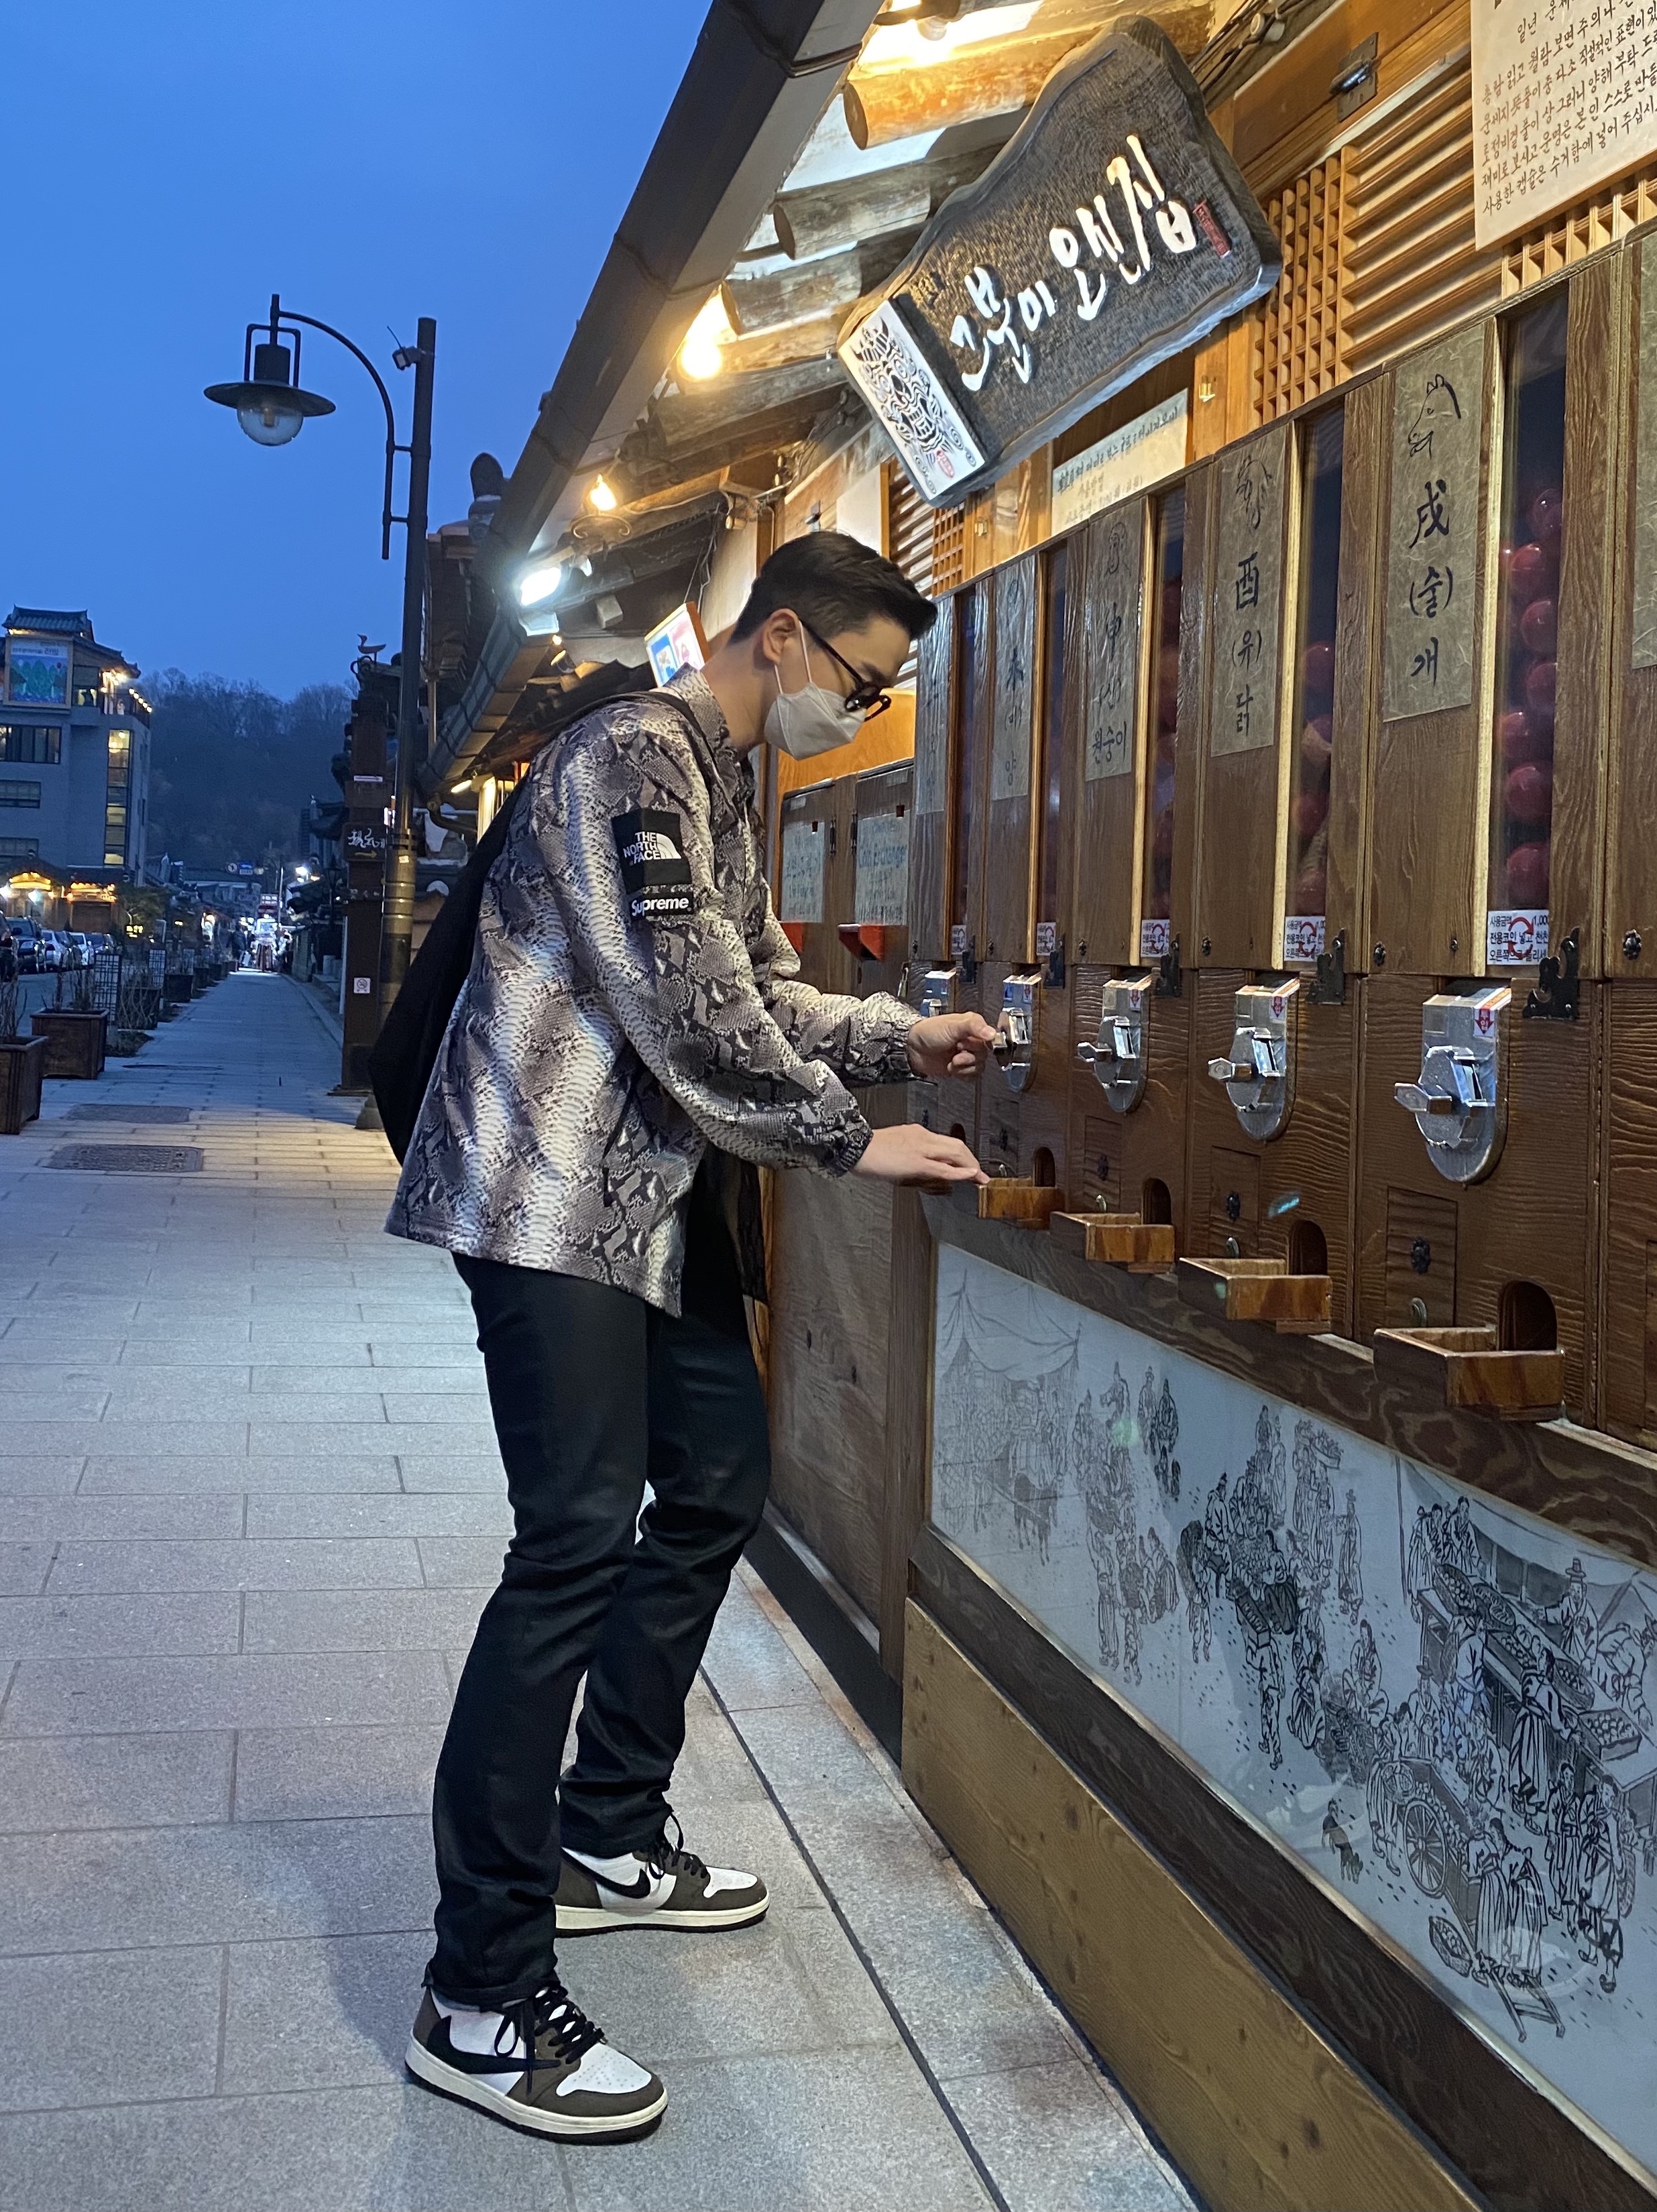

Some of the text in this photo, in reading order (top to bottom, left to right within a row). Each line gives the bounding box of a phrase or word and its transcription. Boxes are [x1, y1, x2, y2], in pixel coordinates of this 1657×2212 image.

[1507, 62, 1525, 90] 읽고
[1553, 24, 1574, 56] 보면
[1577, 0, 1616, 39] 주의나
[1518, 12, 1537, 44] 일년
[1556, 59, 1577, 82] 다소
[1579, 30, 1611, 66] 직설적인
[1615, 9, 1644, 46] 표현이
[1589, 61, 1612, 99] 양해
[1615, 44, 1639, 78] 부탁
[1603, 80, 1633, 113] 스스로
[1483, 95, 1657, 217] 사용한 캡슐은 수거함에 넣어 주십시
[1236, 551, 1259, 612] 酉
[1409, 565, 1453, 618] (술)
[1232, 628, 1262, 673] (유)
[1410, 636, 1440, 688] 개
[1236, 684, 1254, 738] 닭
[1092, 719, 1127, 765] 원숭이
[1005, 750, 1017, 787] 양
[622, 841, 659, 858] NORTH
[633, 850, 661, 865] FACE
[634, 831, 656, 843] THE
[631, 896, 689, 917] Supreme
[1490, 915, 1512, 927] 사용금액
[1490, 931, 1517, 944] 전용코인
